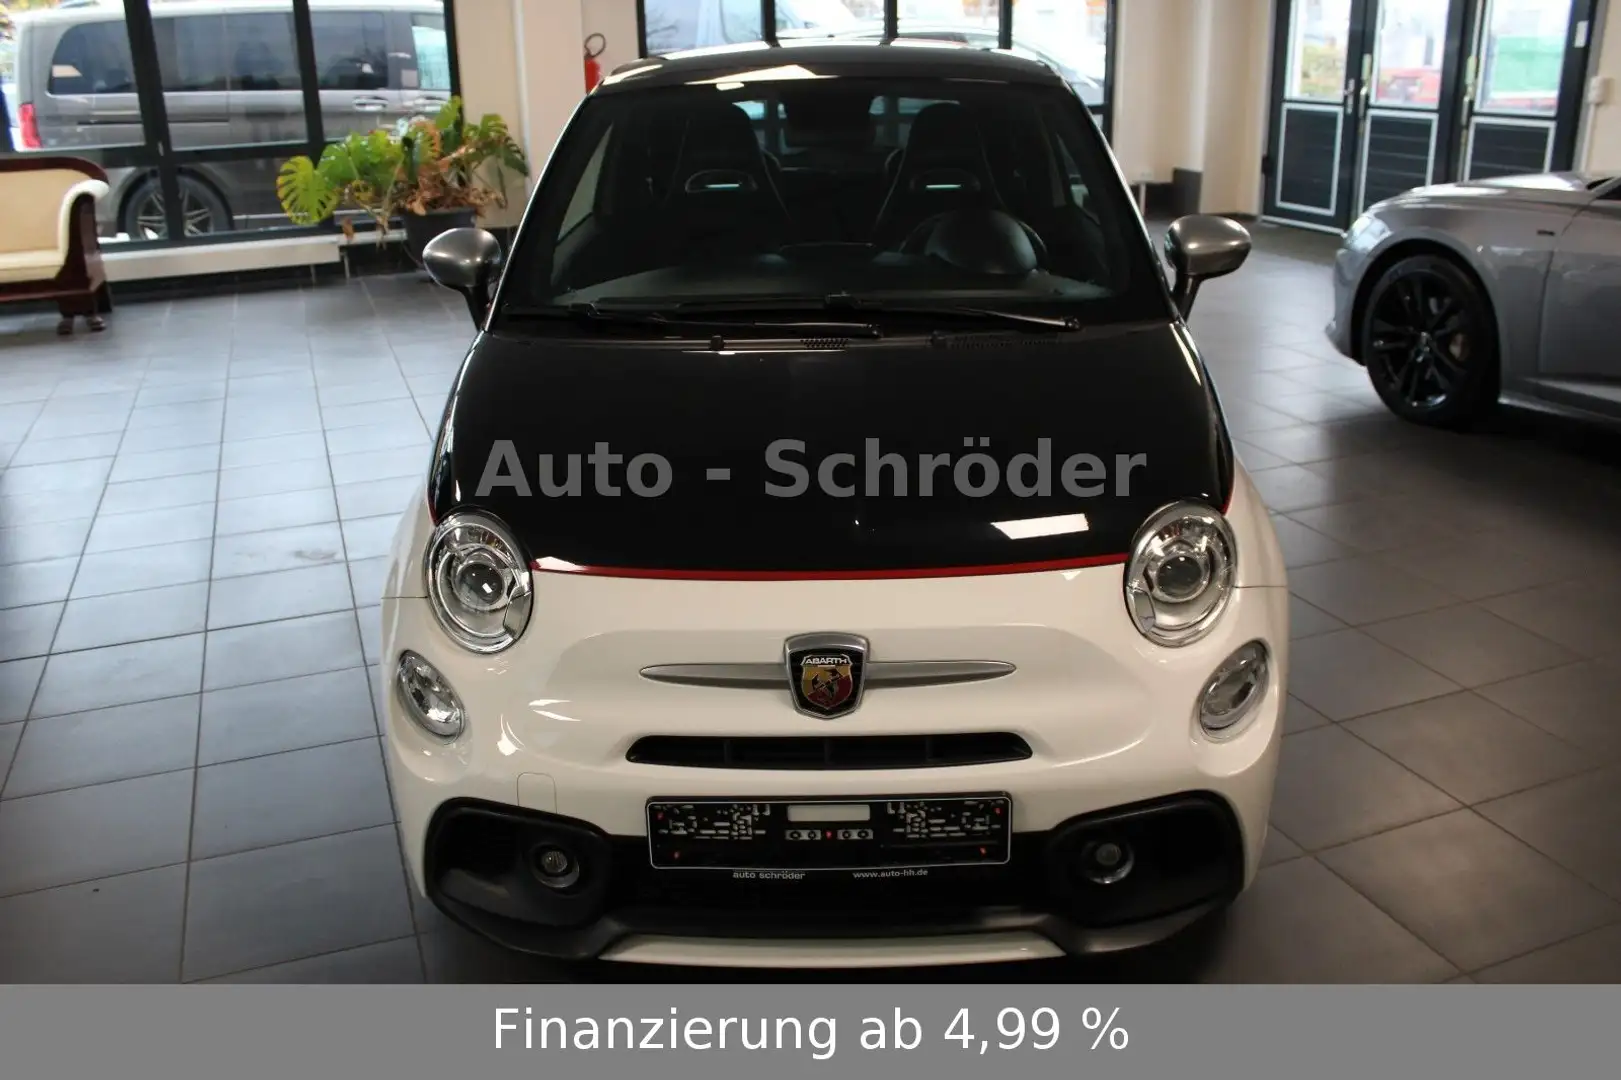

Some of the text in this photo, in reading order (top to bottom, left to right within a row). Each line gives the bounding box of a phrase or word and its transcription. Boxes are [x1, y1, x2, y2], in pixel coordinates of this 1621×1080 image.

[805, 657, 848, 665] ABARTH
[732, 870, 806, 880] auto schröder
[852, 868, 929, 879] www.auto-hh.de
